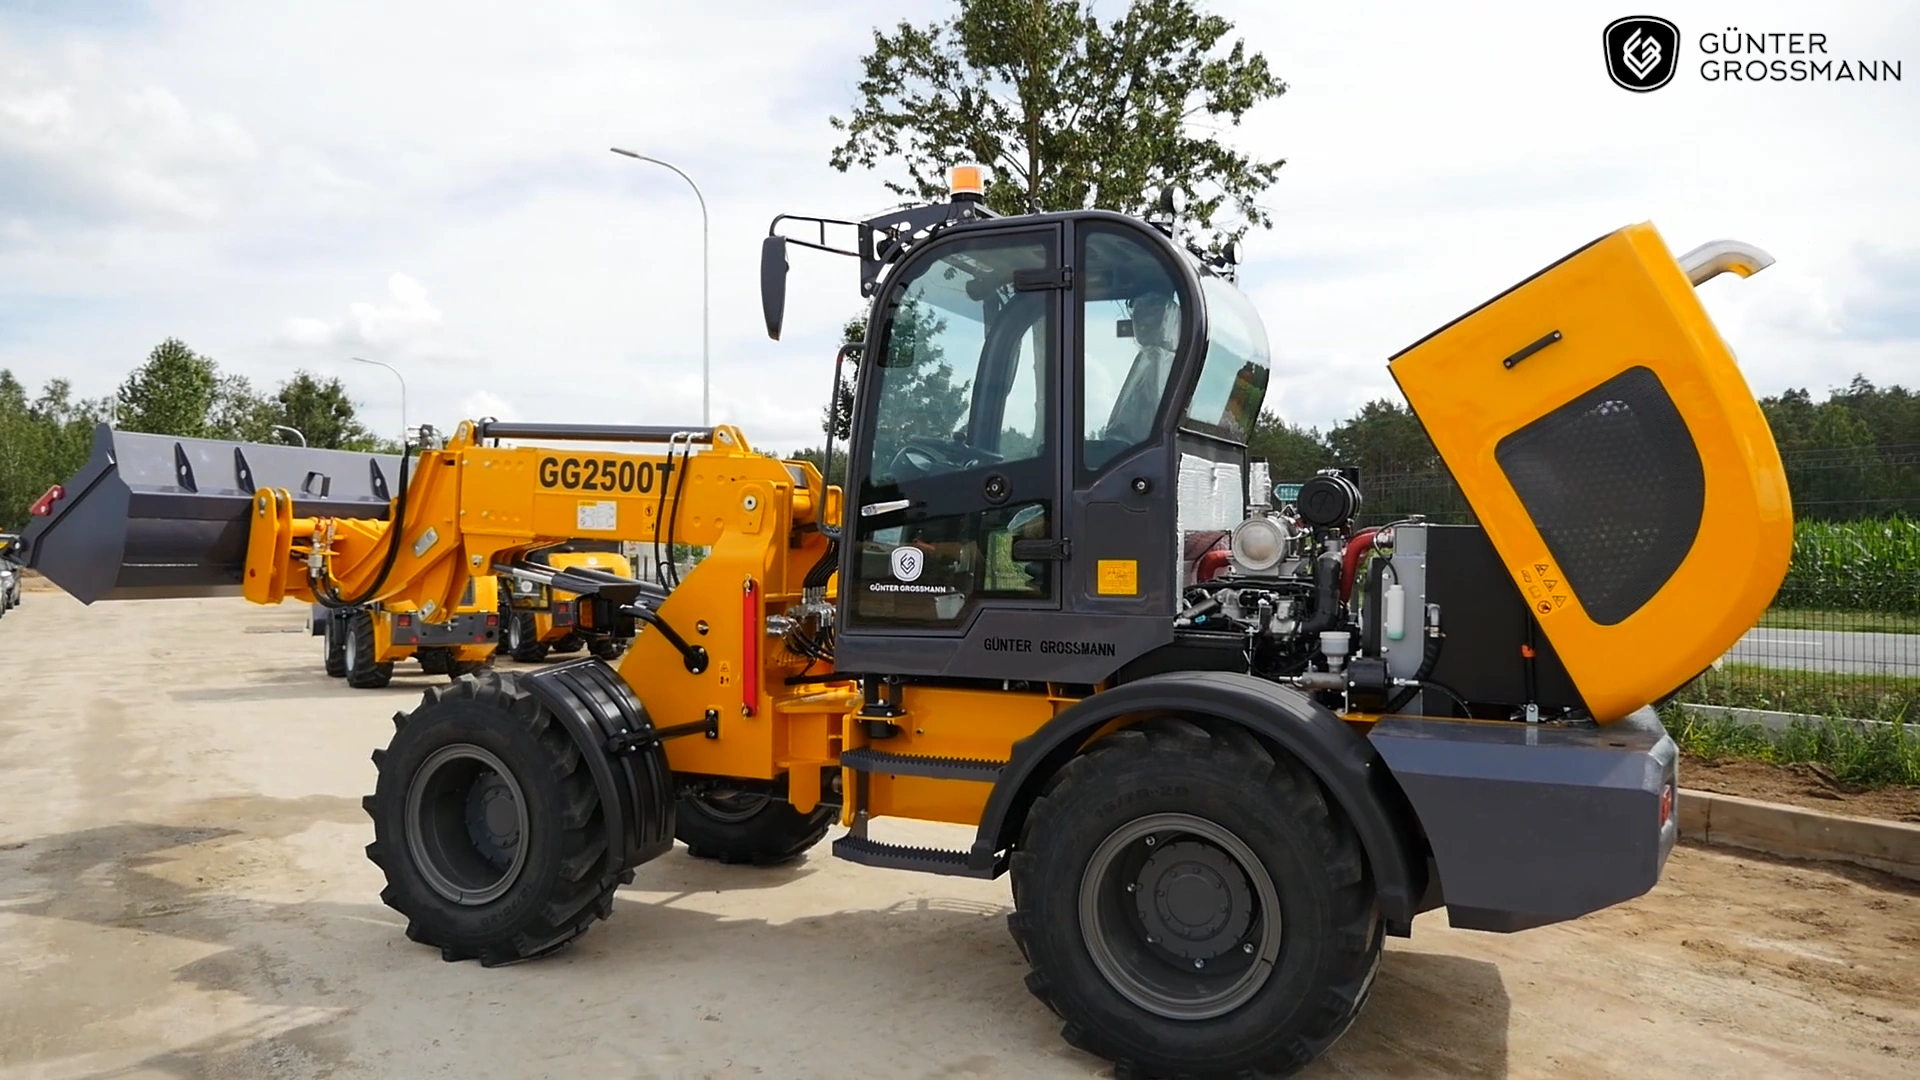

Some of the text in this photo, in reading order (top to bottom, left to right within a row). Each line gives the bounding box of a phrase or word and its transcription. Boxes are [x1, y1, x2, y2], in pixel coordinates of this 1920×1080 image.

[539, 457, 675, 494] GG2500T
[869, 582, 946, 593] GÜNTER GROSSMANN
[984, 636, 1115, 657] GÜNTER GROSSMANN
